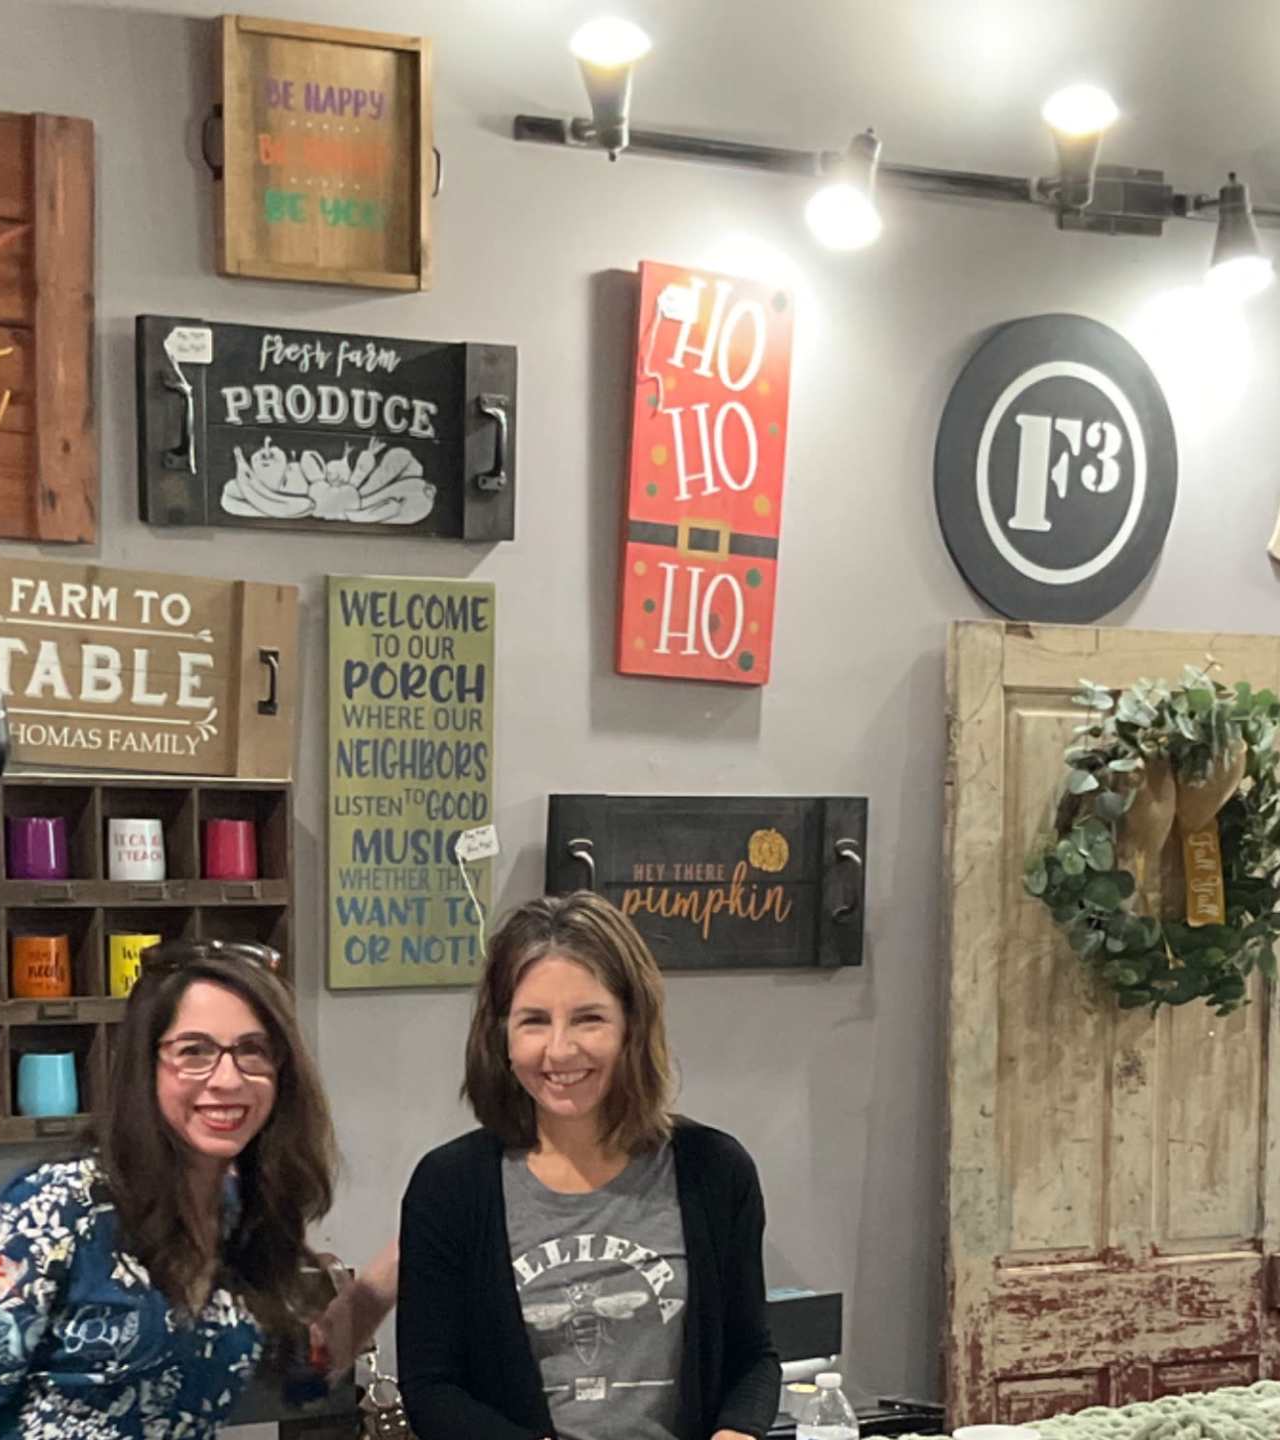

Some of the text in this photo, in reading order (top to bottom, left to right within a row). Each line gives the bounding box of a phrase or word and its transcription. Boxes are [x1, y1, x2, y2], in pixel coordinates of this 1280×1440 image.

[266, 79, 385, 120] BE HAPPY
[260, 334, 402, 378] fresh farm
[666, 276, 767, 392] HO
[221, 384, 439, 439] PRODUCE
[662, 400, 759, 501] HO
[10, 577, 192, 627] FARM TO
[340, 589, 489, 633] WELCOME
[653, 561, 745, 661] HO
[371, 633, 455, 661] TO OUR
[343, 659, 485, 704] PORCH
[342, 703, 483, 732] WHERE OUR
[8, 723, 201, 757] HOMAS FAMILY
[336, 736, 488, 783] NEIGHBORS
[334, 788, 488, 822] LISTEN TO GOOD
[338, 867, 483, 891] WHETHER THEY
[632, 863, 726, 882] HEY THERE
[336, 896, 488, 928] WANT TO
[620, 860, 793, 940] pumpkin
[344, 934, 477, 967] OR NOT!
[513, 1233, 685, 1325] LLIFERA
